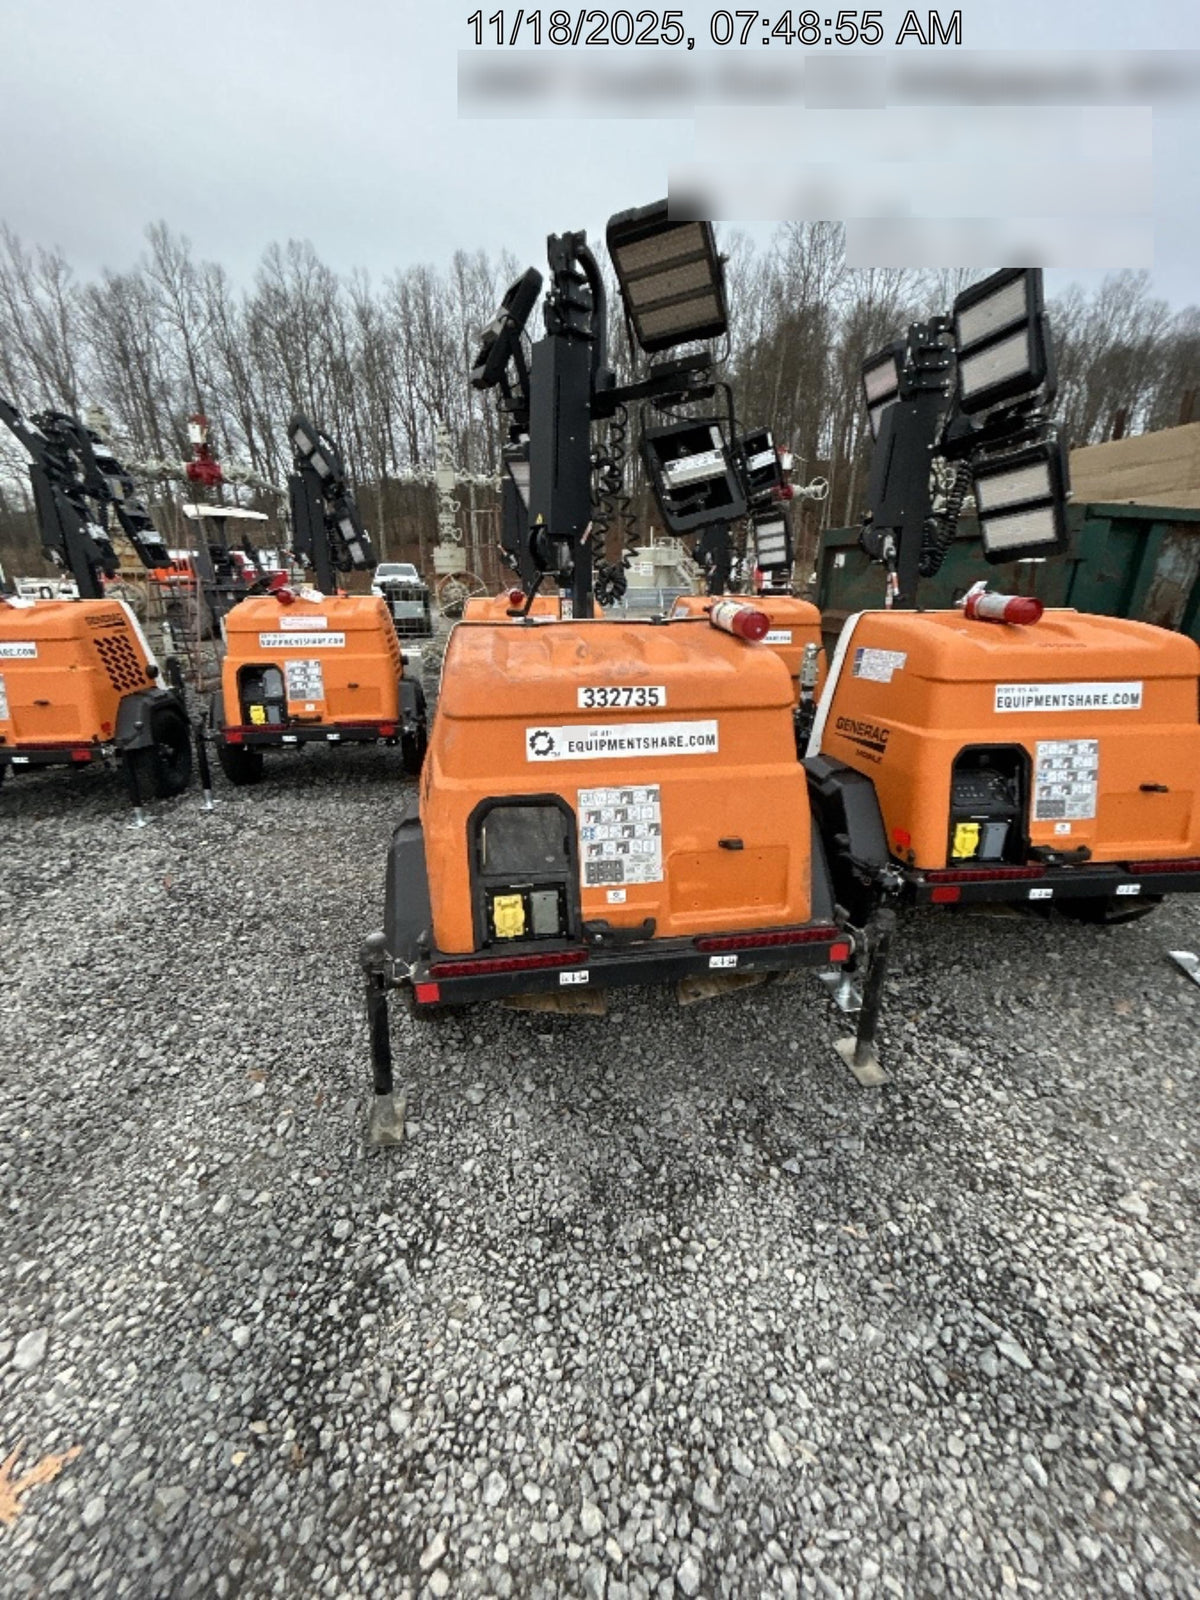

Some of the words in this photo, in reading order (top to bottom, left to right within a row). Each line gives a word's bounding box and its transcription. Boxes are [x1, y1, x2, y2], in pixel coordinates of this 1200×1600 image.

[583, 687, 659, 707] 332735
[996, 693, 1139, 708] EQUIPMENTSHARE.COM
[835, 716, 890, 744] GENERAC
[568, 734, 716, 752] EQUIPMENTSHARE.COM
